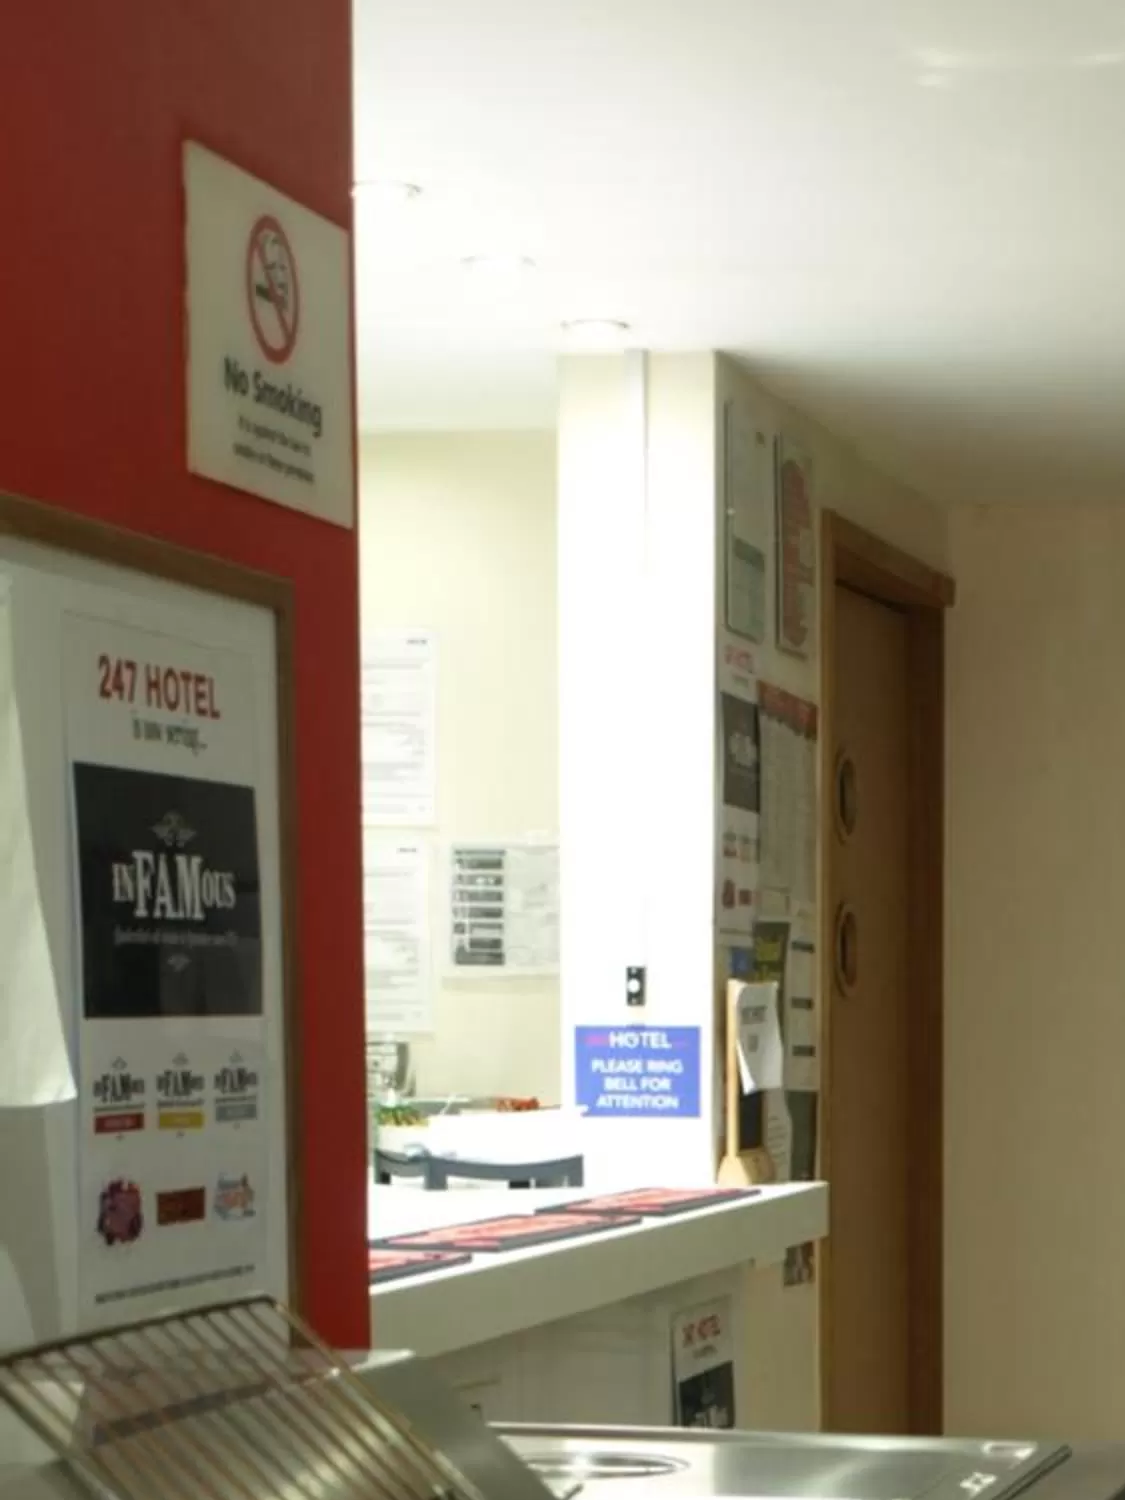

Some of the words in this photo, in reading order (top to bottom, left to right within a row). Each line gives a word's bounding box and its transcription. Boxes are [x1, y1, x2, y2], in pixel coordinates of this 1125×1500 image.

[223, 354, 250, 397] No
[252, 367, 323, 440] Smoking
[98, 653, 138, 704] 247
[145, 663, 221, 721] HOTEL
[609, 1031, 672, 1050] HOTEL
[591, 1058, 643, 1074] PLEASE
[647, 1059, 684, 1074] RING
[603, 1076, 638, 1091] BELL
[641, 1077, 672, 1091] FOR
[595, 1094, 680, 1110] ATTENTION
